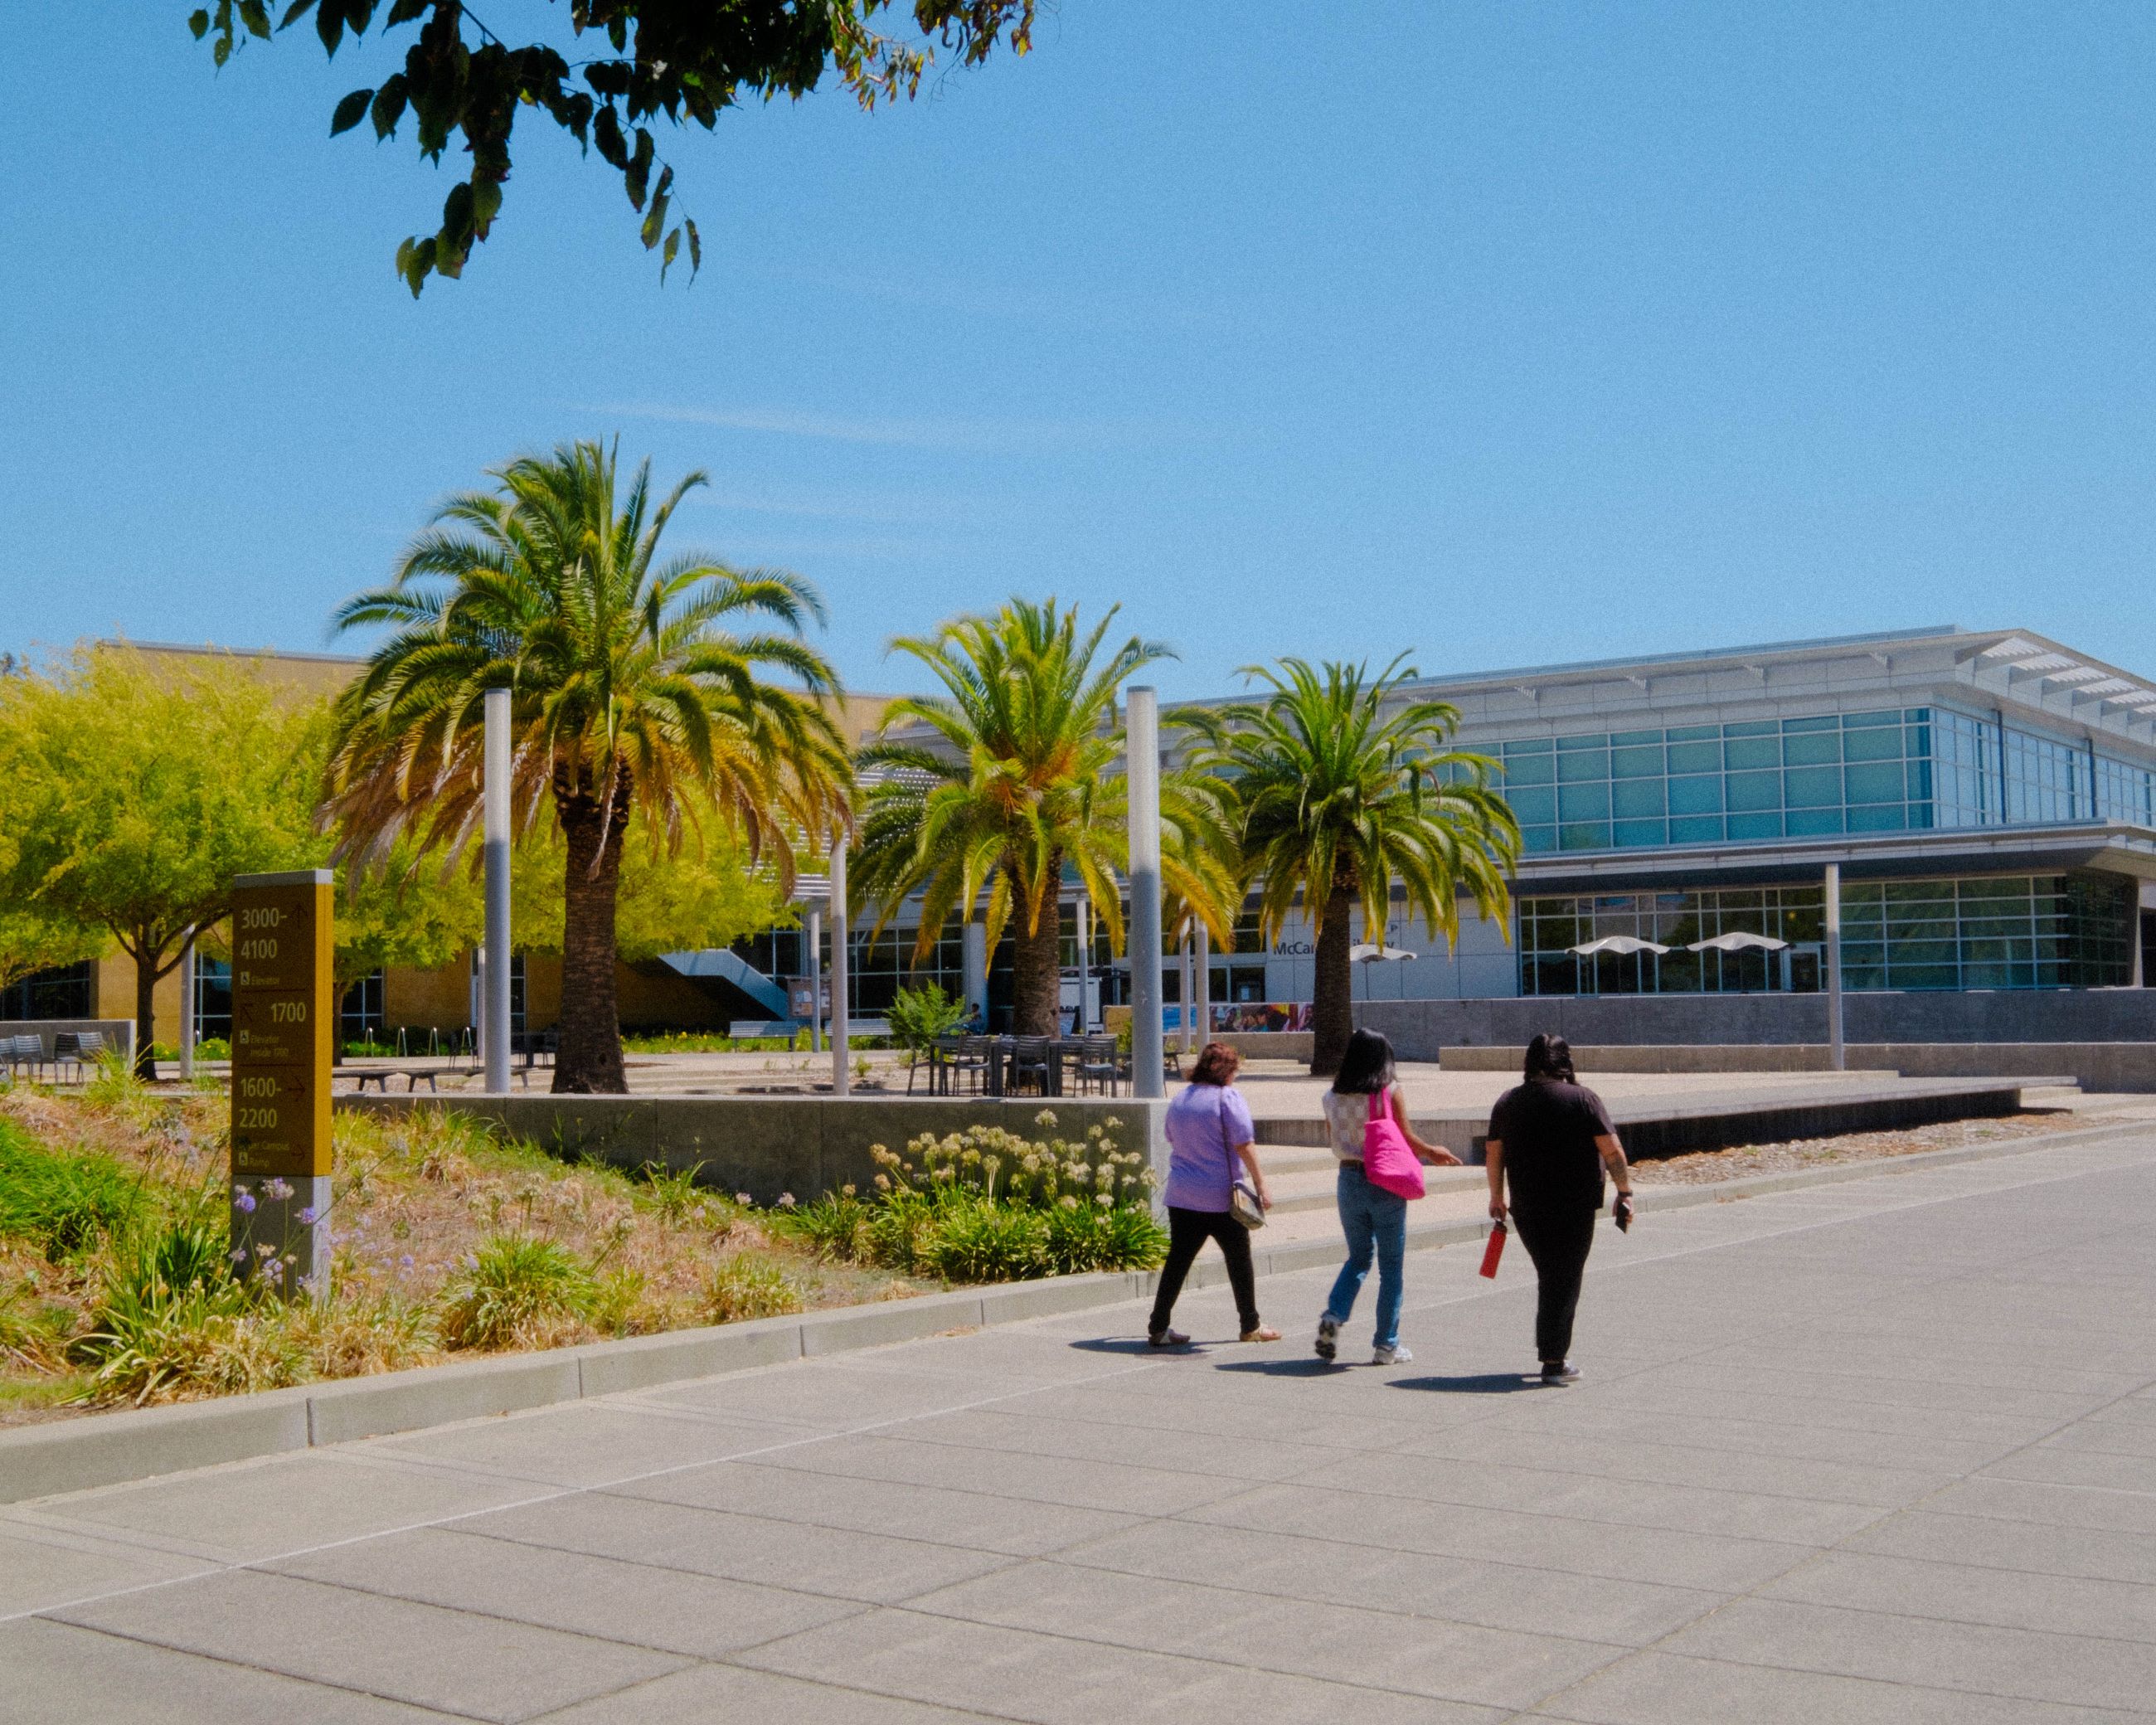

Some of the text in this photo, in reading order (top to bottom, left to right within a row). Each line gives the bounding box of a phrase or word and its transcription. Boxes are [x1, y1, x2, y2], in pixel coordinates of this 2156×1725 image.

[240, 907, 288, 929] 3000-
[240, 939, 278, 960] 4100
[270, 1002, 307, 1023] 1700
[240, 1077, 282, 1097] 1600-
[239, 1108, 278, 1128] 2200
